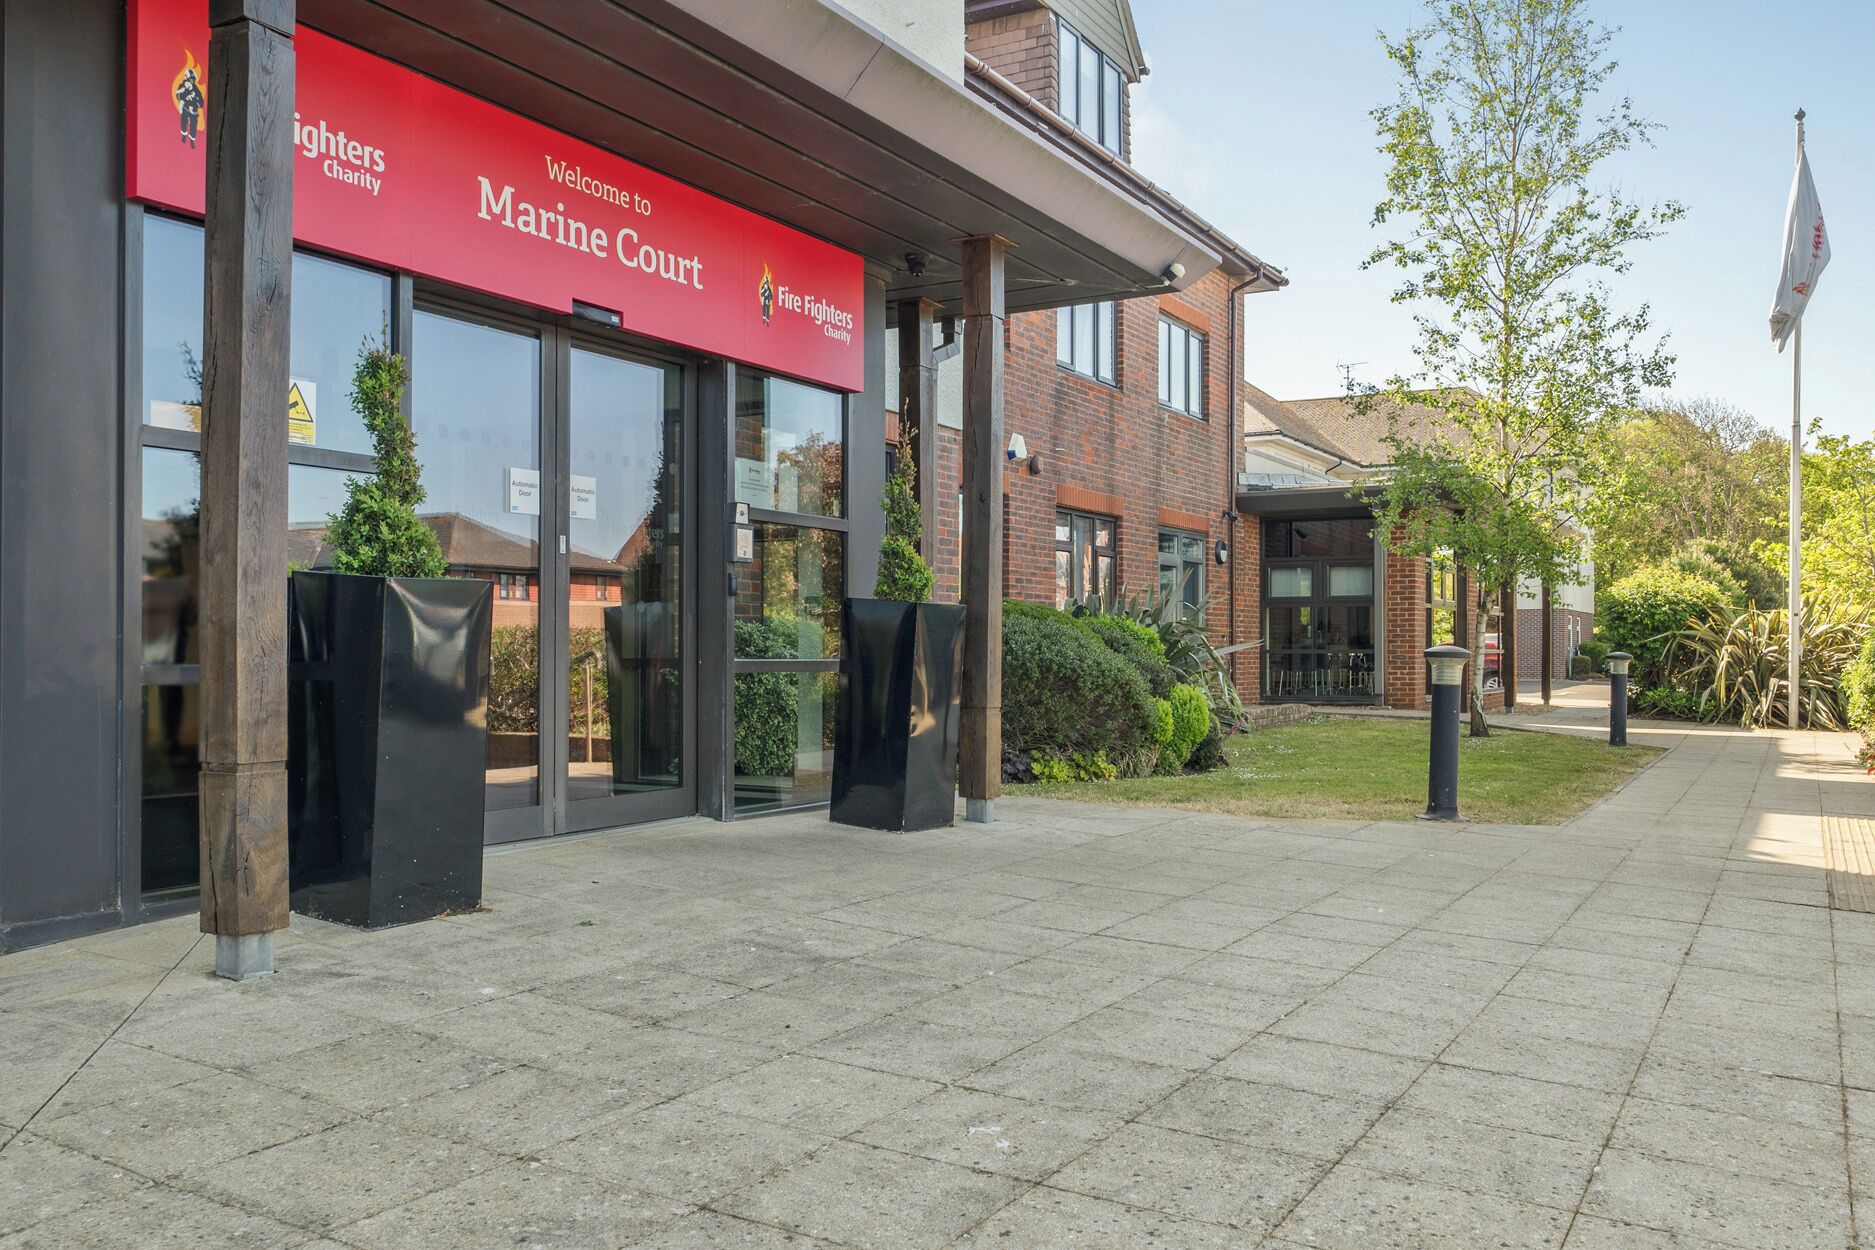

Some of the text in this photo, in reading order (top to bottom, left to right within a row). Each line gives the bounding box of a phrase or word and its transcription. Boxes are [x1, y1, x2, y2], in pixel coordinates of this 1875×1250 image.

[294, 112, 386, 173] ighters
[323, 159, 382, 196] Charity
[545, 155, 652, 216] Welcome to
[477, 175, 704, 290] Marine Court
[778, 285, 853, 329] Fire Fighters
[824, 323, 851, 346] Charity
[511, 480, 539, 489] Automatic
[571, 486, 596, 496] Automatic
